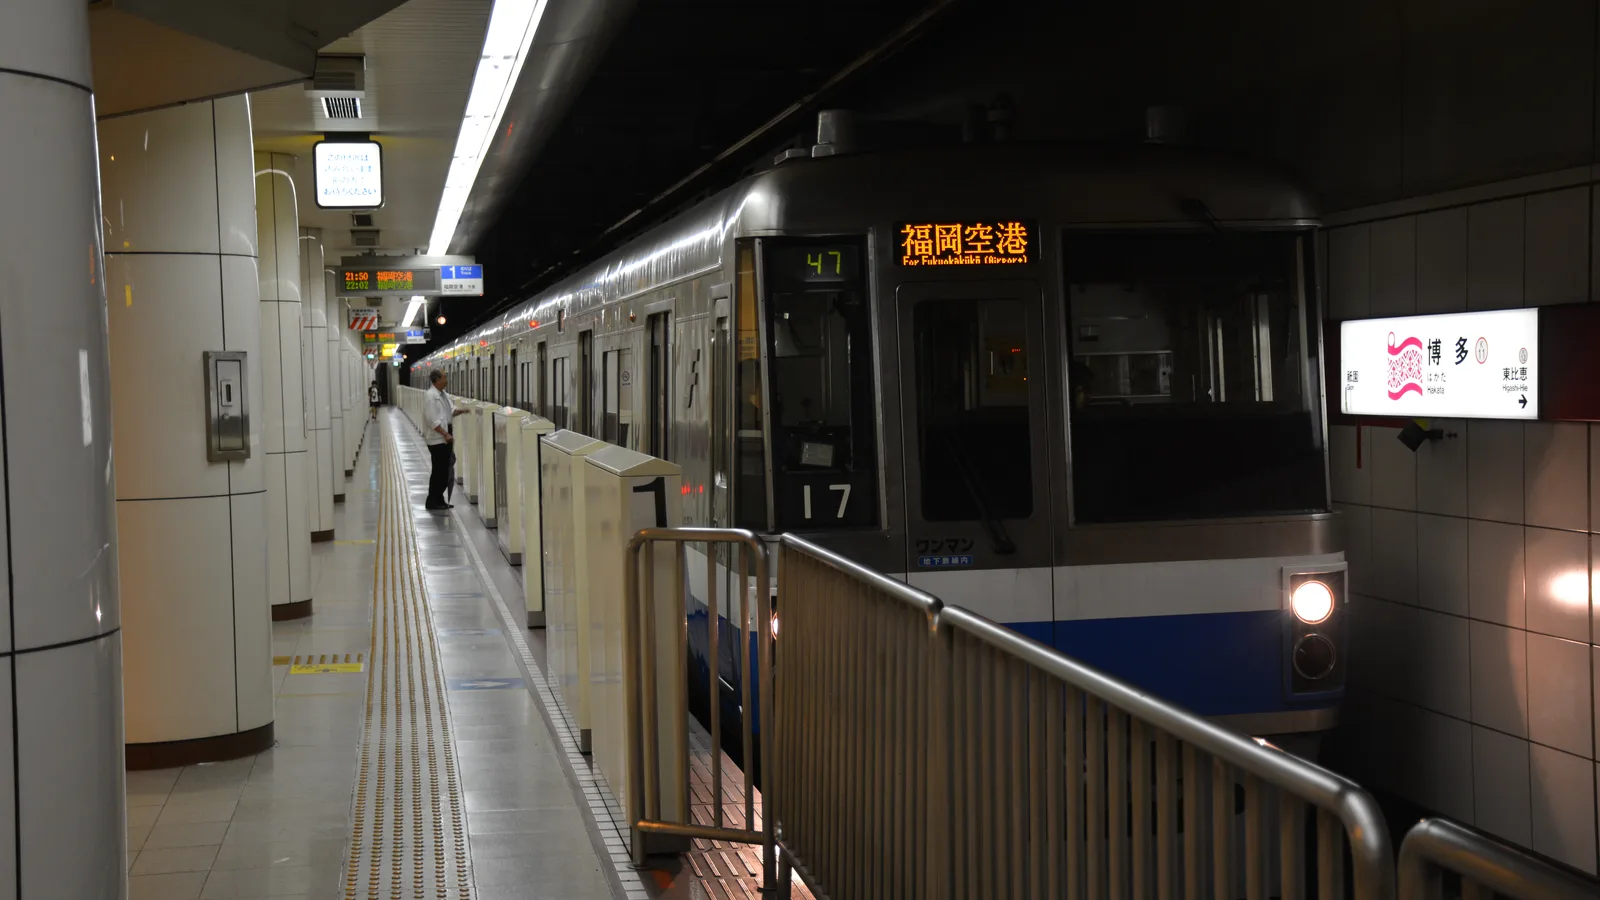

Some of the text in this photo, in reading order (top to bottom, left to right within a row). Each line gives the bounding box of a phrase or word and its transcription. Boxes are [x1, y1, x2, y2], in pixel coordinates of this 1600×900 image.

[900, 222, 1028, 256] 福岡空港
[806, 250, 842, 276] 47
[902, 255, 919, 266] For
[345, 271, 413, 281] 21:50 福岡空港
[449, 265, 456, 279] 1
[345, 280, 413, 290] 22:02 福岡空港
[1427, 336, 1469, 366] 博多
[1427, 372, 1446, 382] はかた
[1502, 367, 1528, 382] 東比恵
[1426, 385, 1445, 395] Hakata
[1502, 383, 1528, 393] Higashi-Hie
[632, 476, 667, 528] 1
[803, 483, 852, 520] 17
[915, 538, 975, 554] ワンマン
[923, 556, 969, 566] 地下鉄線内
